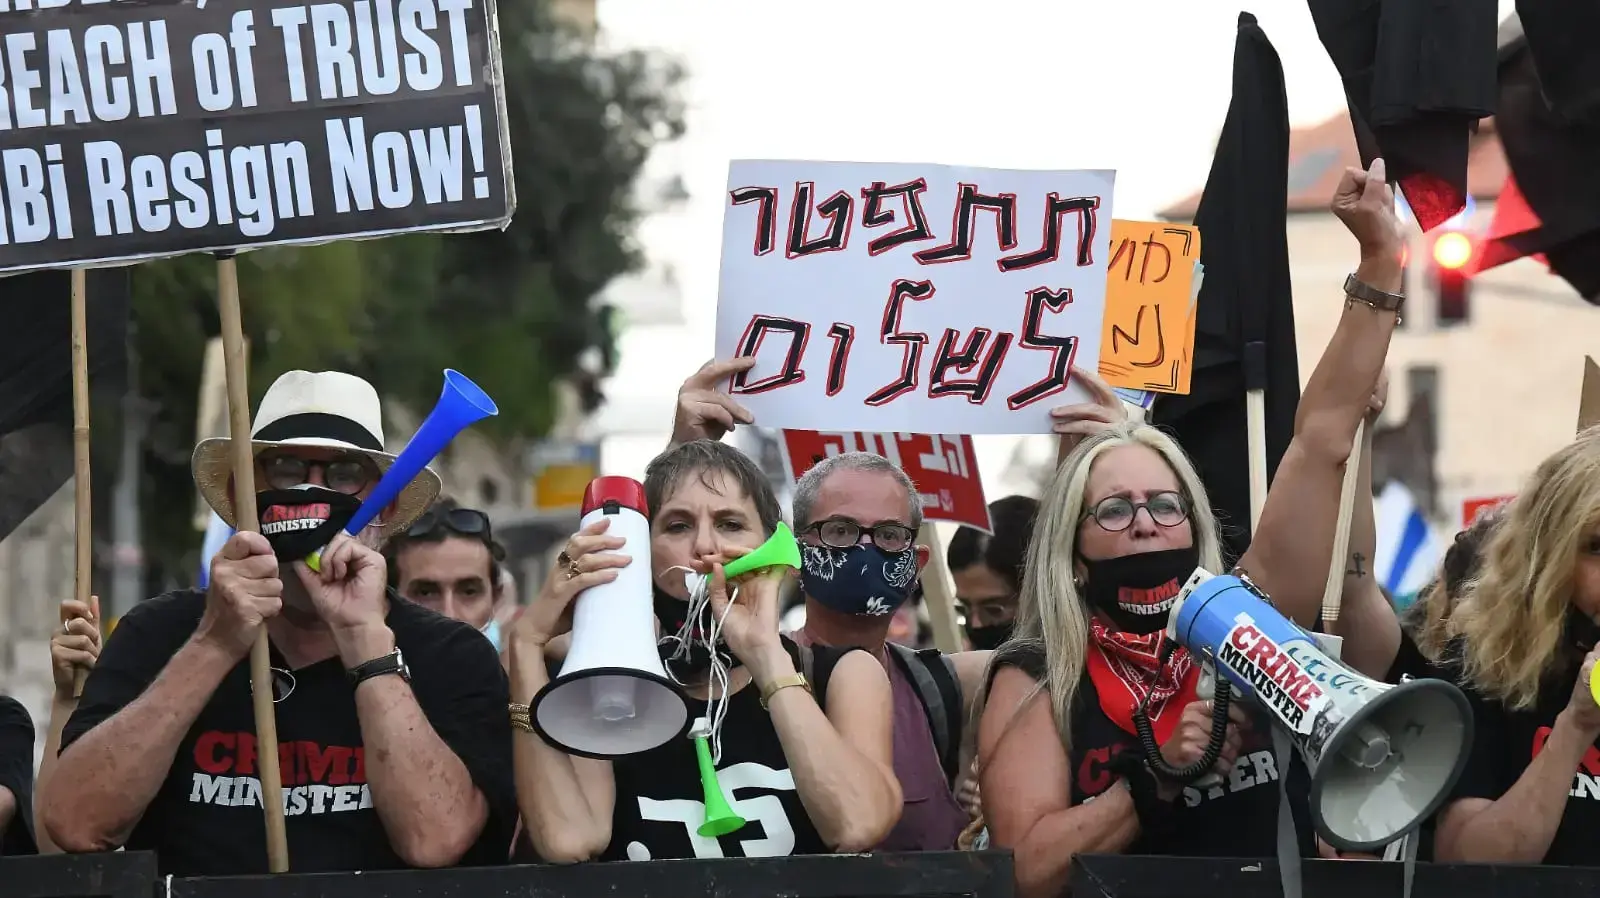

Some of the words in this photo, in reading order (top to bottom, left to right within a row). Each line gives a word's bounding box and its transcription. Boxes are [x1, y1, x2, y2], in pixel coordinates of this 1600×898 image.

[0, 19, 178, 130] EACH
[191, 9, 259, 112] of
[271, 0, 473, 103] TRUST
[0, 143, 74, 245] Bi
[84, 128, 315, 237] Resign
[325, 104, 490, 214] Now!
[730, 178, 1101, 272] תתפטר
[729, 278, 1079, 410] לשלום
[262, 503, 331, 523] CRIME
[1219, 641, 1304, 729] MINISTER
[1231, 624, 1323, 713] CRIME
